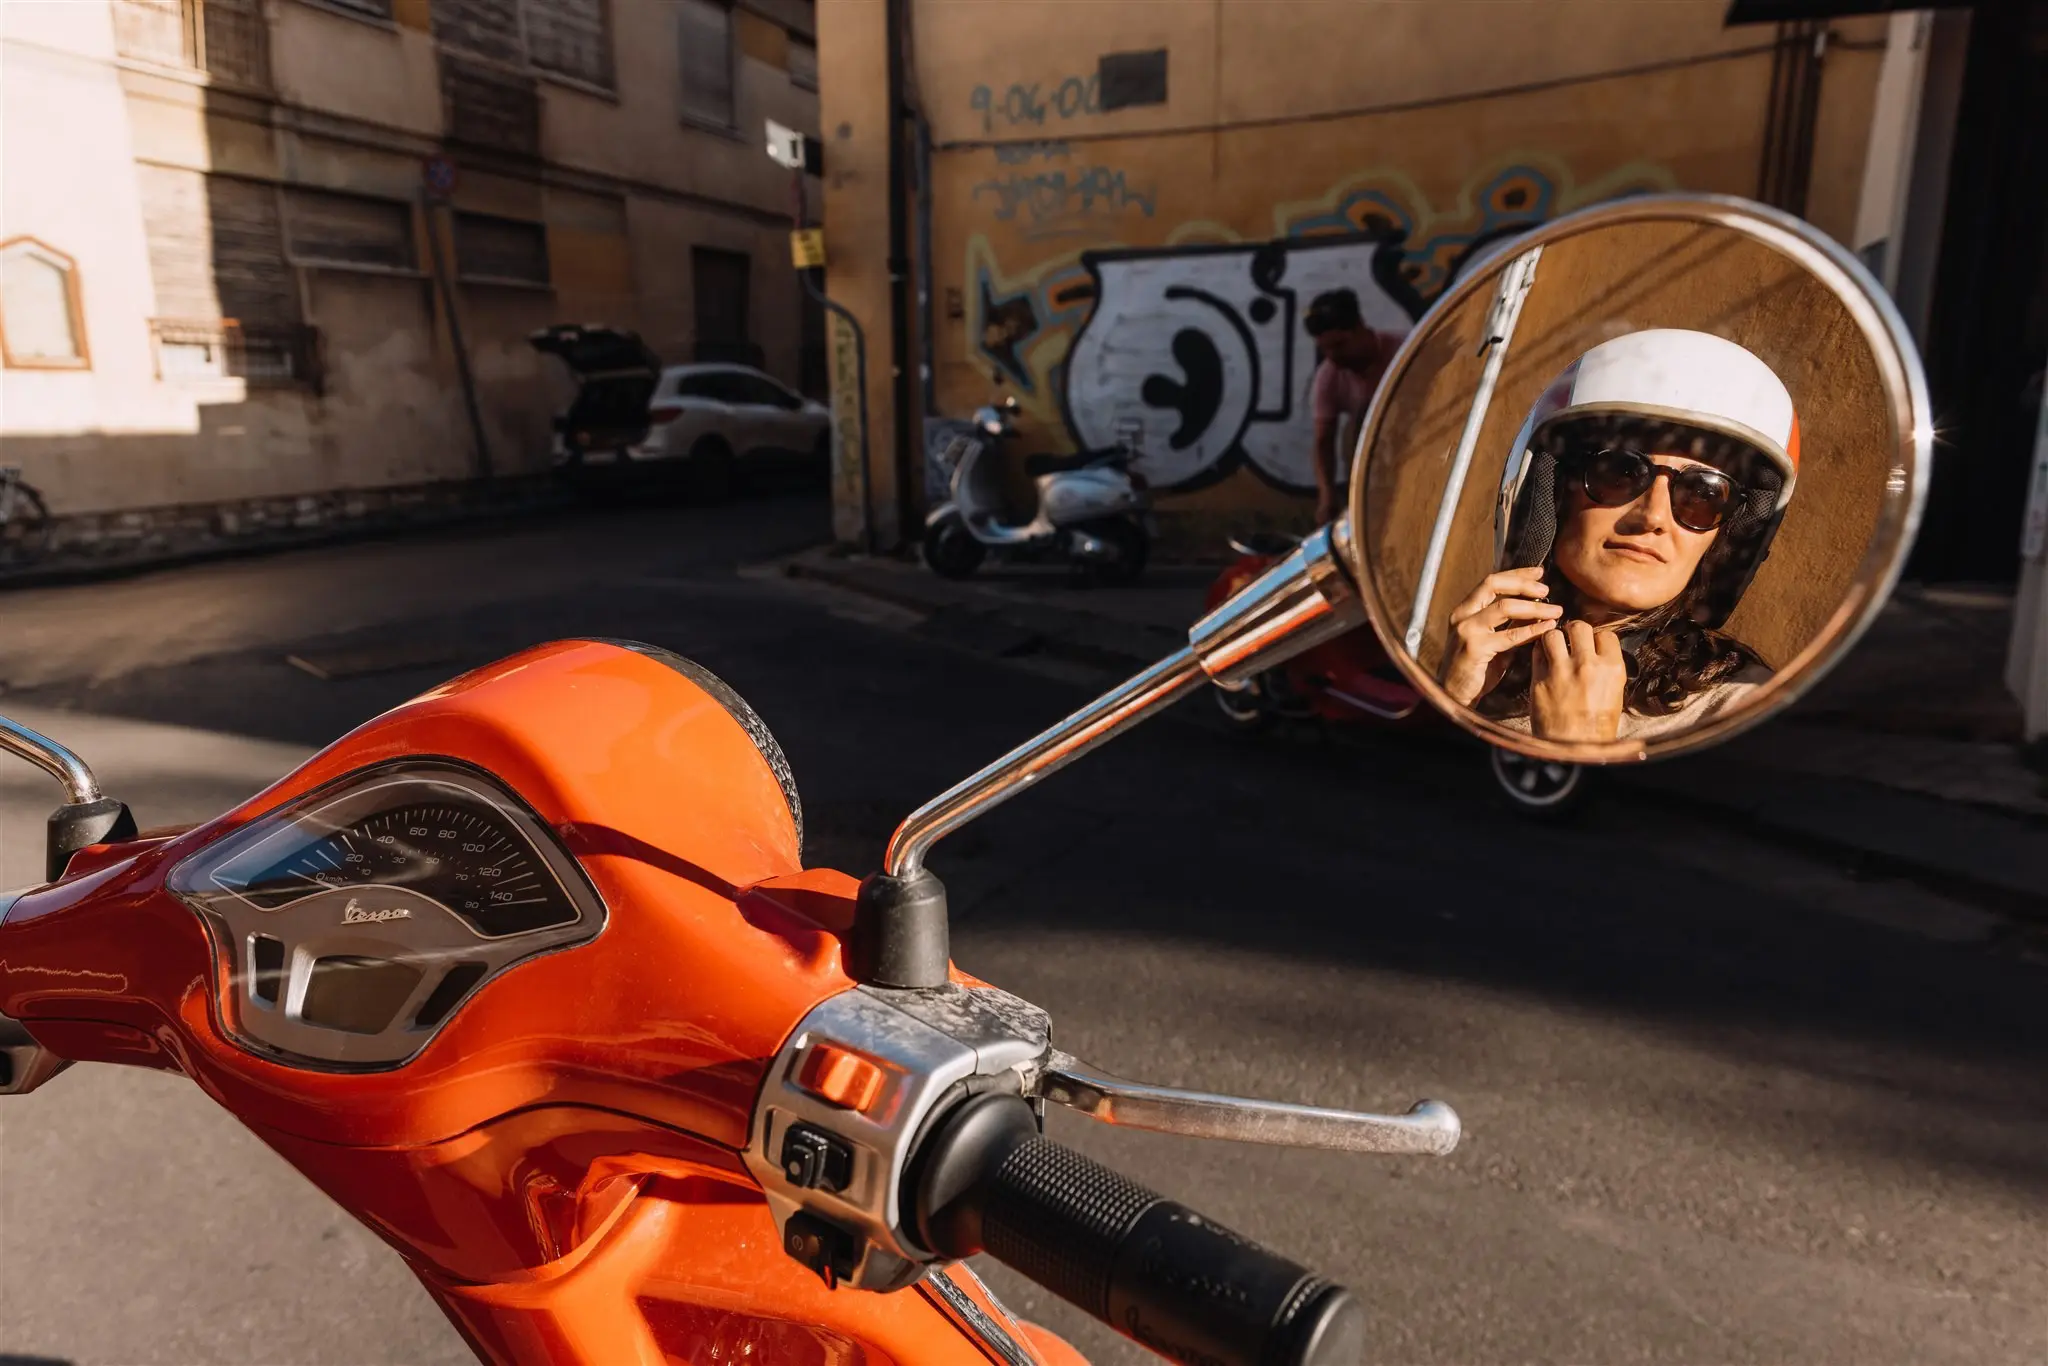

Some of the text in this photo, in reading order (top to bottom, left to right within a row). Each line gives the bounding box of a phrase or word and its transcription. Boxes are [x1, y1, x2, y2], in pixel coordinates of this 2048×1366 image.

[409, 827, 428, 837] 60
[438, 829, 457, 839] 80
[376, 835, 395, 845] 40
[461, 842, 486, 853] 100
[345, 853, 364, 863] 20
[455, 873, 469, 881] 70
[478, 866, 502, 878] 120
[489, 890, 514, 902] 140
[464, 901, 480, 909] 90
[341, 898, 412, 925] Vespa
